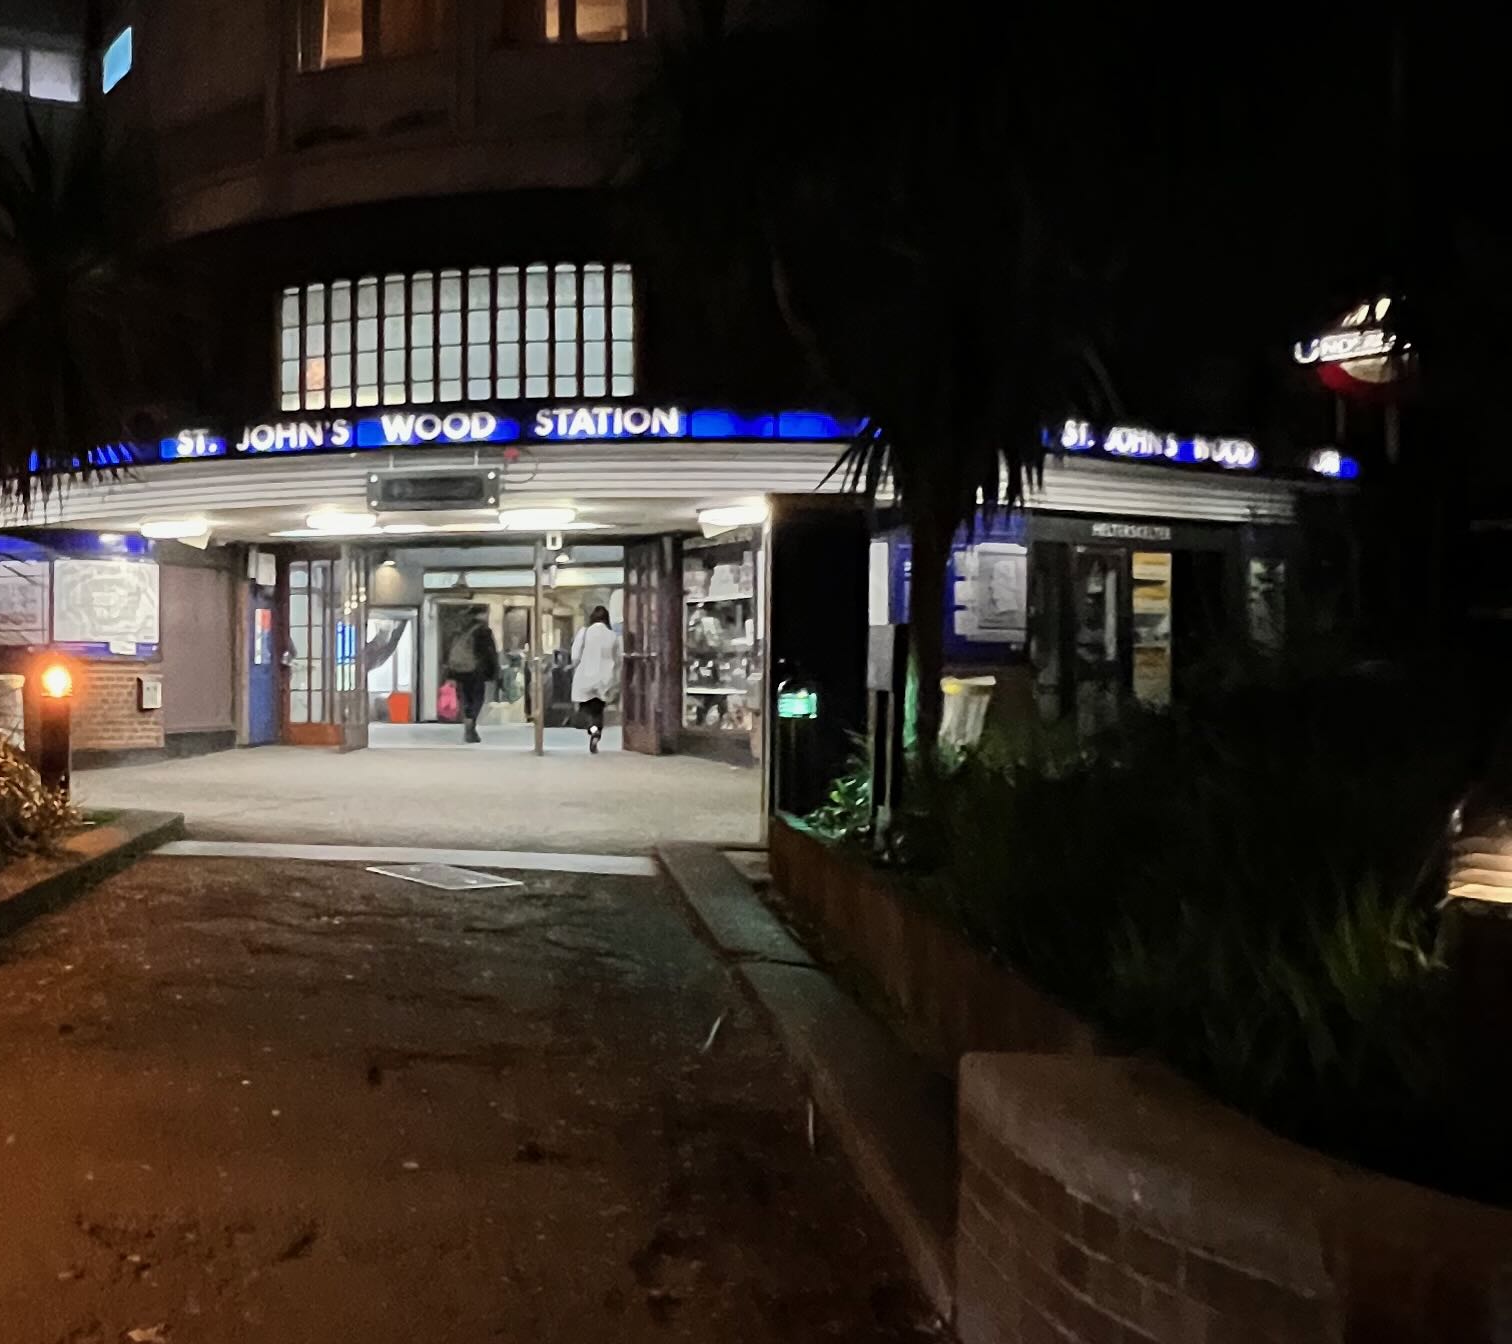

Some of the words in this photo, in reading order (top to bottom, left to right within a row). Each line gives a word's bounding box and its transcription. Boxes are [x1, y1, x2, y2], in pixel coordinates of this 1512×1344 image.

[176, 428, 218, 455] ST.
[235, 419, 350, 452] JOHN'S
[380, 411, 496, 442] WOOD
[534, 407, 680, 437] STATION
